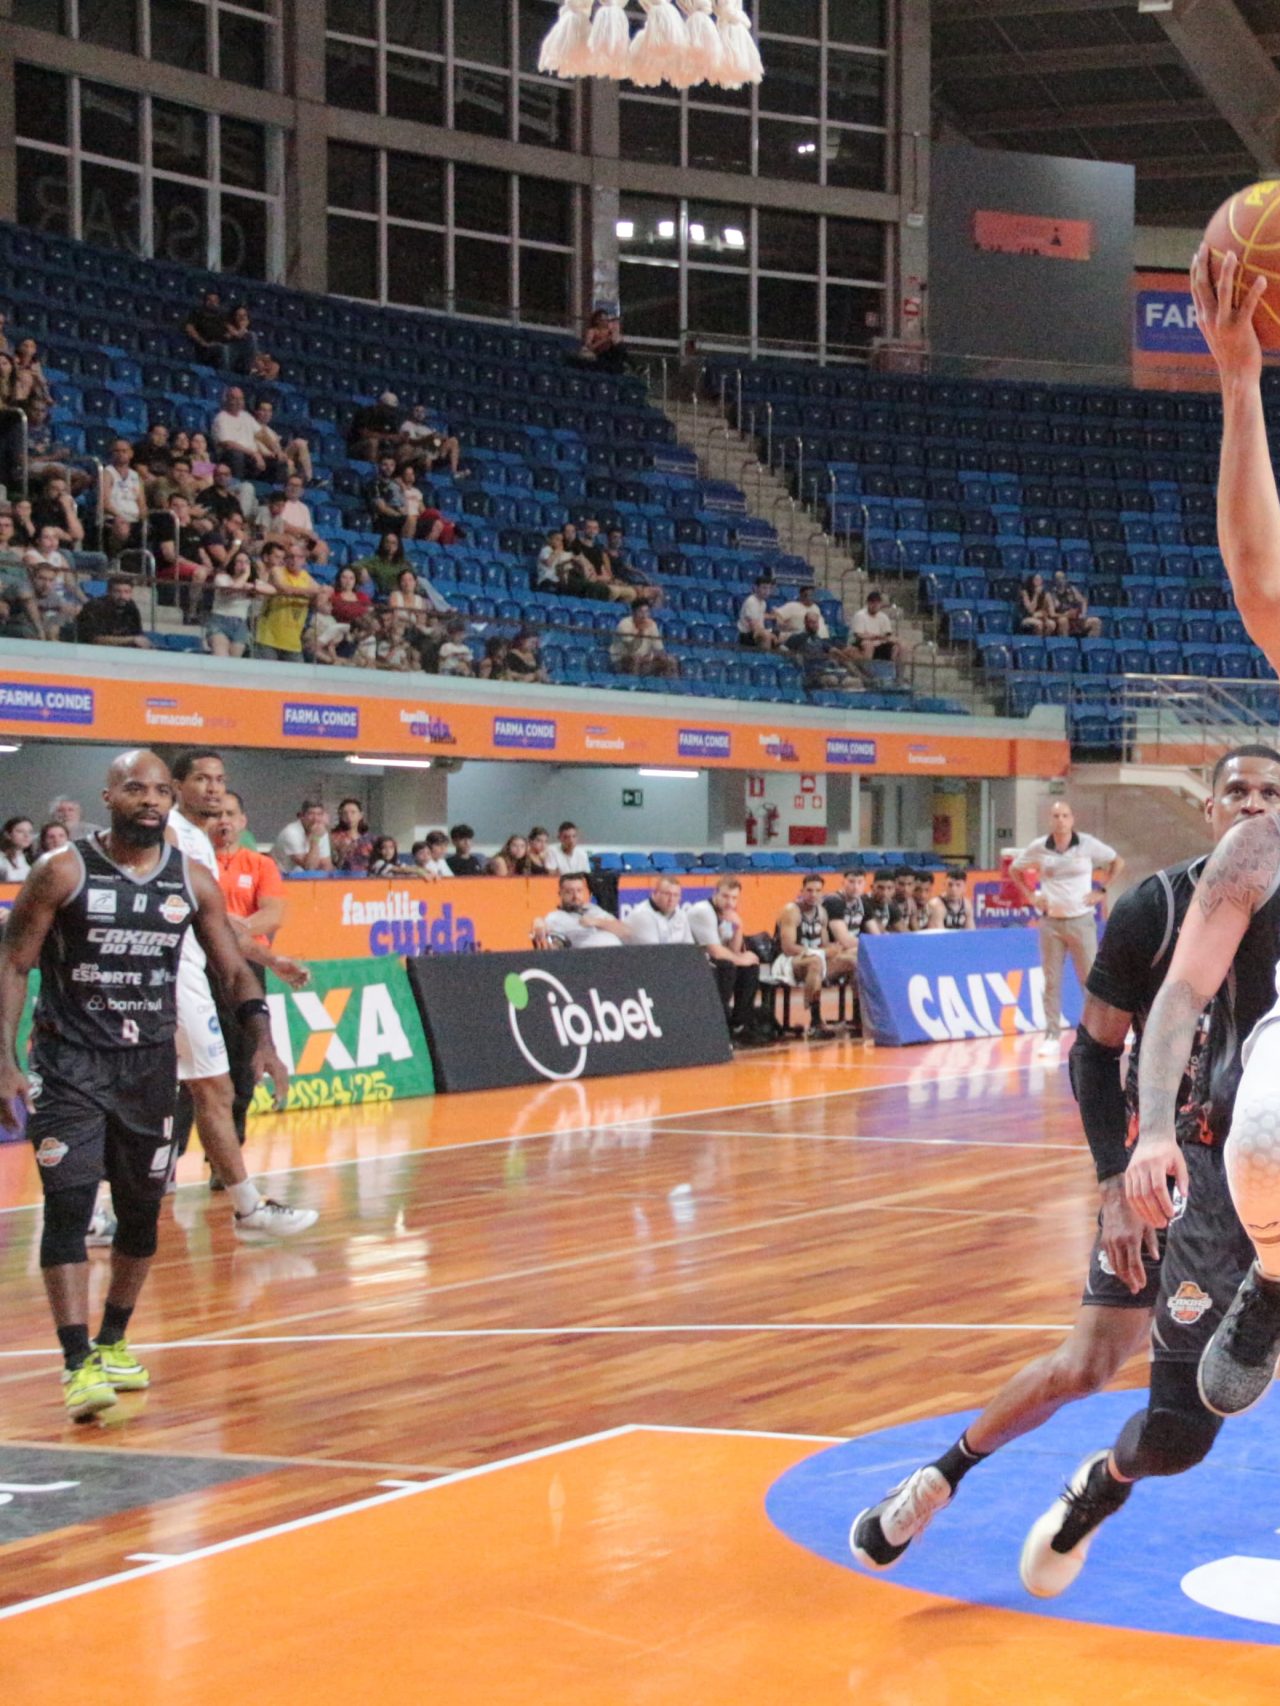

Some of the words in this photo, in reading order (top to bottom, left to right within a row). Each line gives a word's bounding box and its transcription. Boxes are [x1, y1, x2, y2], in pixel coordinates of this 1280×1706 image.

[0, 688, 44, 707] FARMA
[46, 693, 93, 711] CONDE
[284, 707, 320, 724] FARMA
[322, 710, 357, 727] CONDE
[495, 721, 524, 736] FARMA
[525, 723, 554, 739] CONDE
[679, 732, 704, 746] FARMA
[705, 735, 730, 748] CONDE
[86, 928, 181, 949] CAXIAS
[99, 943, 127, 955] DO
[129, 944, 164, 957] SUL
[71, 968, 143, 986] ESPORTE
[548, 987, 663, 1047] io.bet
[121, 1018, 140, 1044] 4
